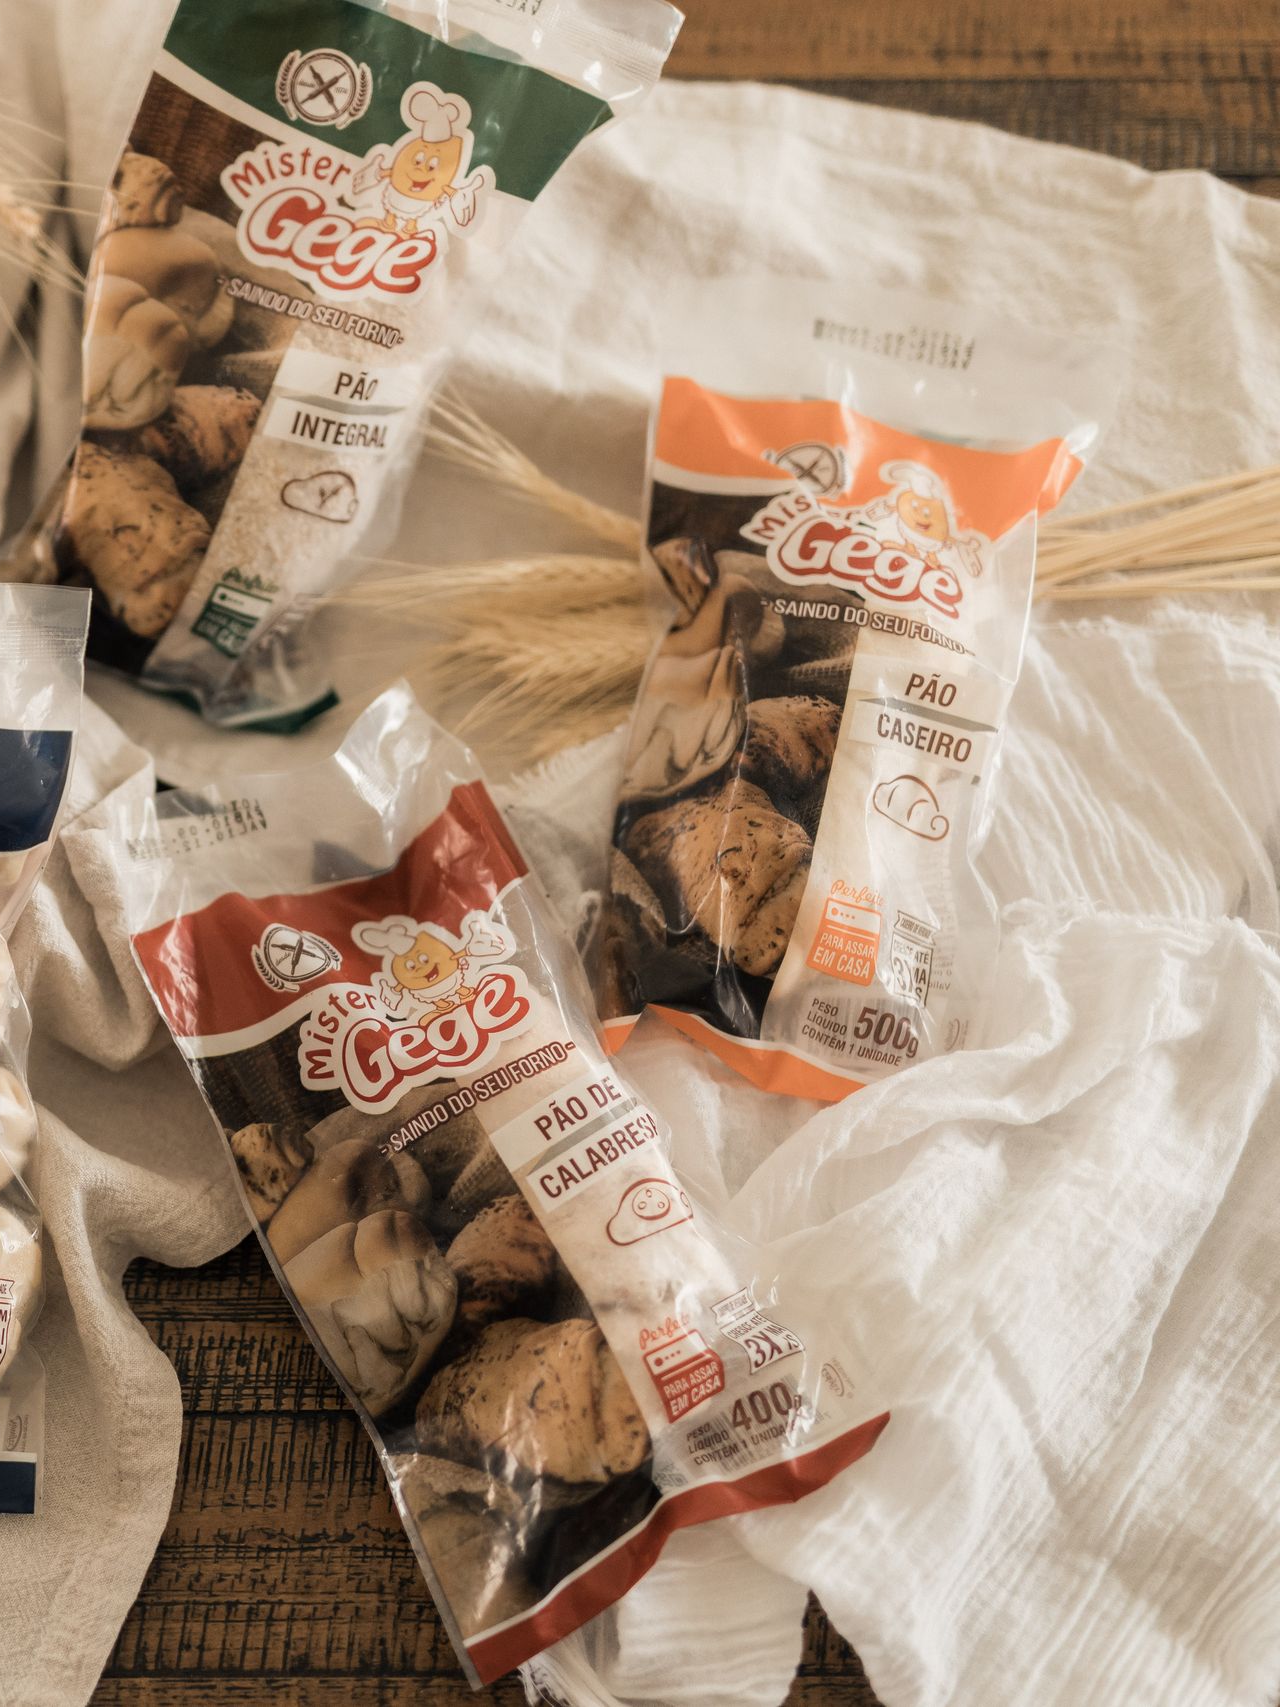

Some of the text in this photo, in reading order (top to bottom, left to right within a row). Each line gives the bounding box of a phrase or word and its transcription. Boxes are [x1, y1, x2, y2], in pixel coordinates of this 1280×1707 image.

[229, 146, 351, 200] Mister
[227, 277, 399, 349] SAINDO DO SEU FORNO
[291, 411, 388, 449] INTEGRAL
[773, 598, 966, 656] SAINDO DO SEU FORNO
[905, 673, 958, 709] PÃO
[877, 713, 972, 763] CASEIRO
[812, 946, 871, 979] EM CASA
[820, 932, 875, 960] PARA ASSAR
[807, 1009, 848, 1037] LÍQUIDO
[811, 997, 838, 1017] PESO
[307, 987, 377, 1081] Mister
[801, 1025, 903, 1068] CONTÉM 1 UNIDADE
[853, 1006, 920, 1060] 500g
[389, 1043, 566, 1149] SAINDO DO SEU FORNO
[533, 1076, 622, 1141] PÃO DE
[539, 1112, 658, 1198] CALABRESA
[743, 1330, 784, 1369] 3X
[664, 1361, 719, 1400] PARA ASSAR
[670, 1377, 721, 1416] EM CASA
[686, 1424, 712, 1442] PESO
[694, 1443, 741, 1466] CONTÉM
